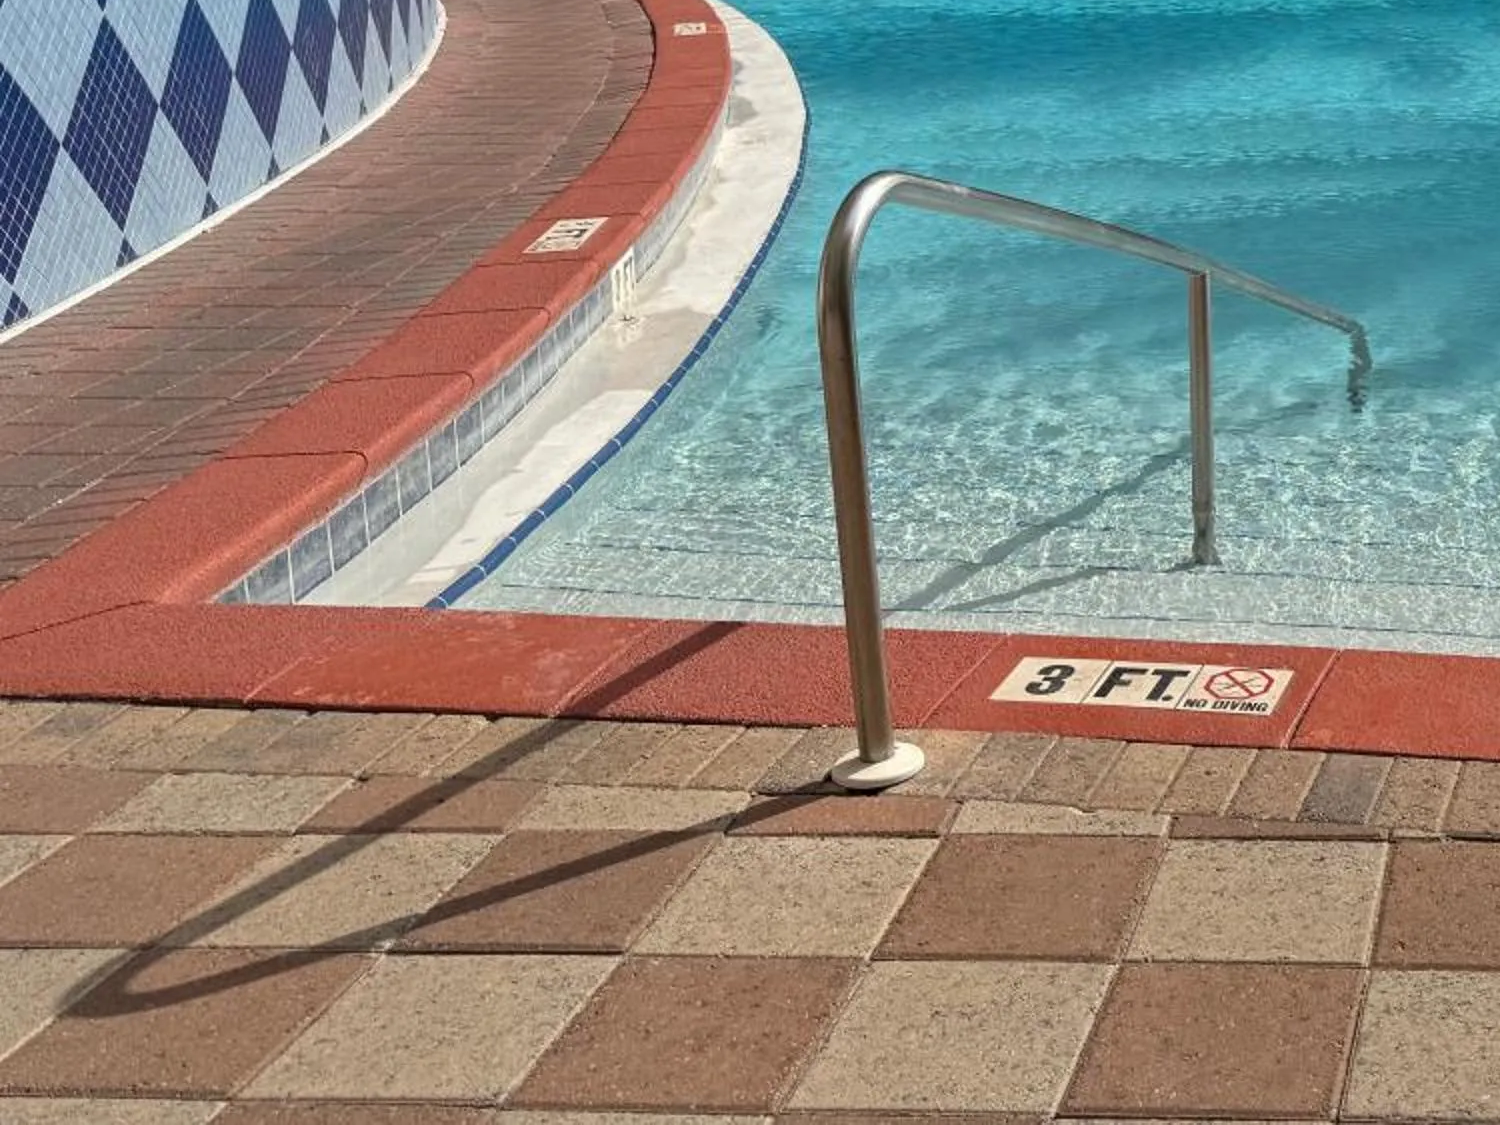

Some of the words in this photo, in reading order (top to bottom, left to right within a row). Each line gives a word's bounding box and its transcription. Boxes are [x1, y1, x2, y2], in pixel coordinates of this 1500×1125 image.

[1025, 664, 1075, 696] 3
[1093, 667, 1191, 702] FT.
[1183, 698, 1208, 708] NO
[1211, 700, 1269, 712] DIVING
